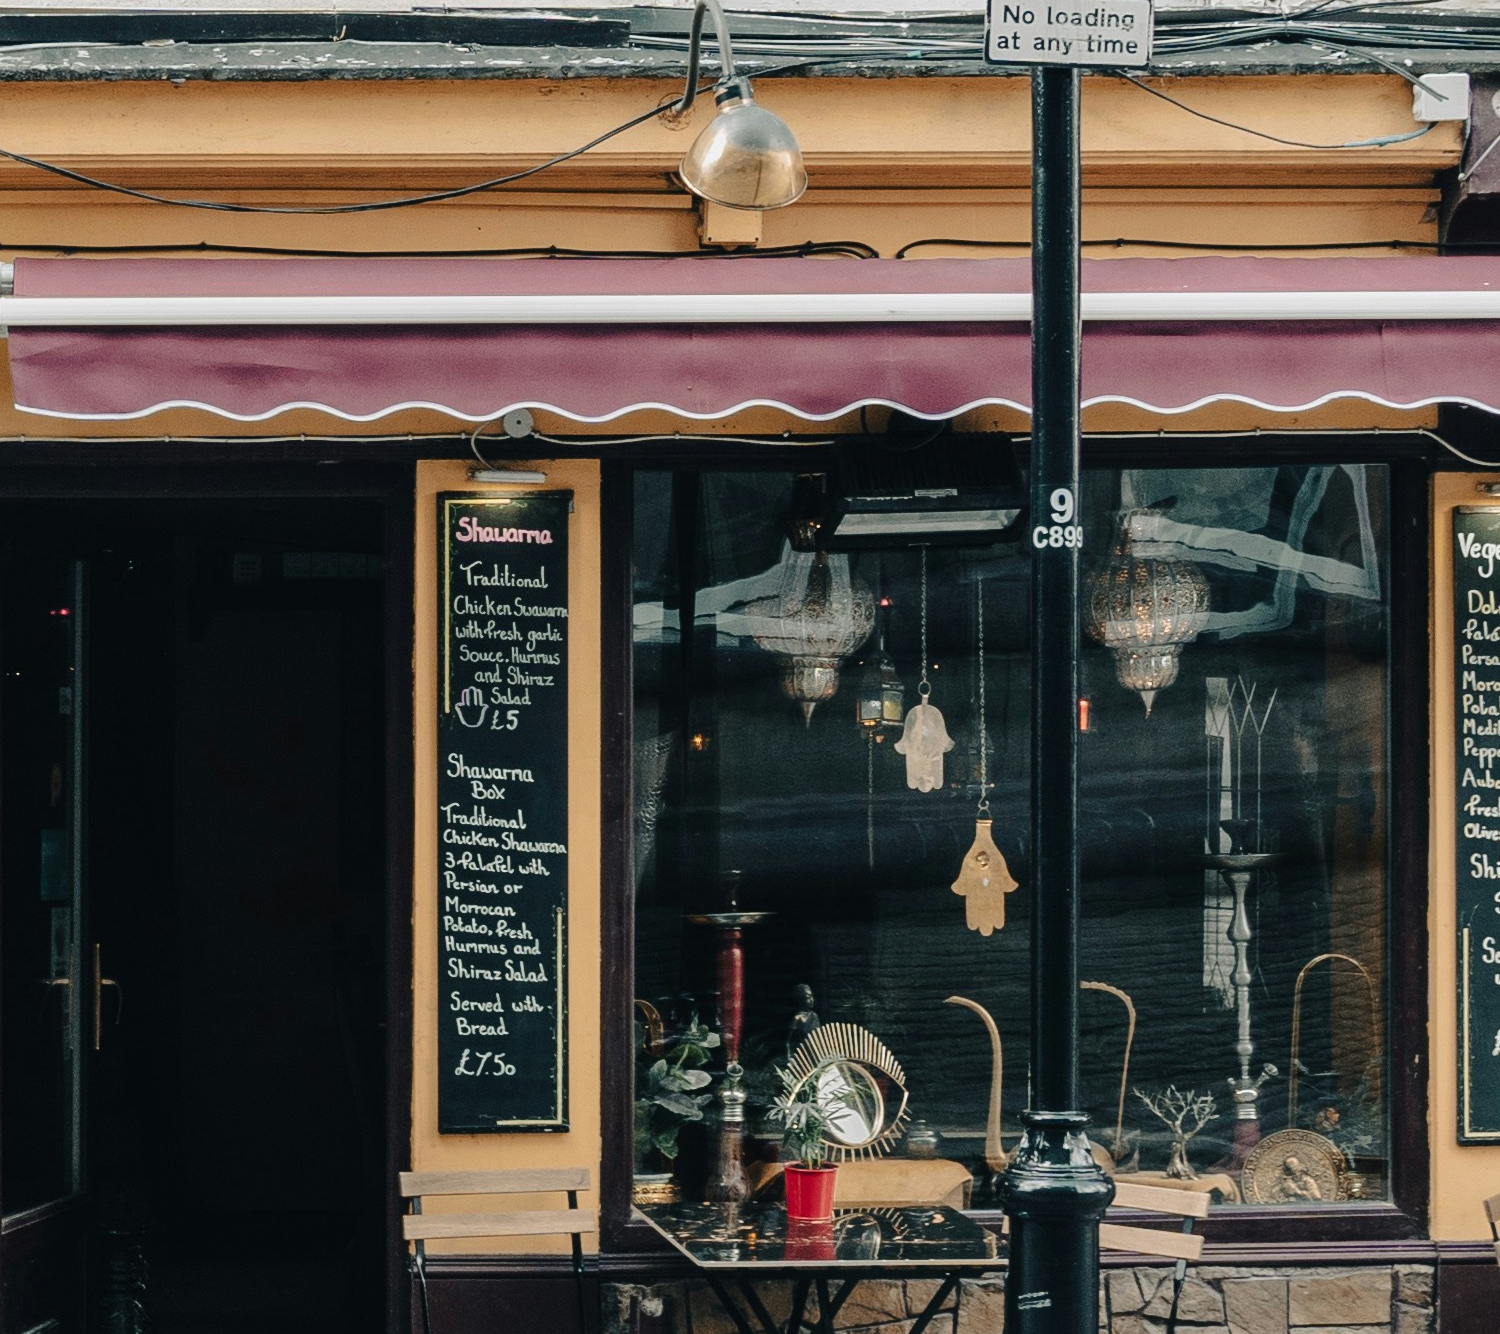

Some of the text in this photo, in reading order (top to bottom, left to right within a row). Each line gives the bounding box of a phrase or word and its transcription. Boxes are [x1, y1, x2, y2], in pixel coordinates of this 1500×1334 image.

[1003, 5, 1134, 32] No loading
[997, 31, 1138, 55] at any time
[1050, 488, 1074, 524] 9
[460, 560, 548, 588] Traditional
[454, 595, 512, 615] Chicken
[456, 620, 483, 638] with
[526, 623, 563, 651] garlic
[474, 663, 554, 686] and Shiraz
[491, 687, 531, 705] Salad
[491, 709, 519, 730] £5
[471, 780, 505, 800] Box
[441, 803, 526, 829] Traditional
[443, 829, 499, 847] Chicken
[445, 852, 550, 876] 3 with
[444, 871, 523, 894] Persian or
[445, 896, 516, 916] Morrocan
[495, 920, 533, 940] fresh
[445, 936, 541, 955] Hummus and
[447, 957, 548, 982] Shiraz Salad
[450, 991, 504, 1012] Served
[456, 1017, 509, 1035] Bread
[454, 1048, 516, 1077] £7.50
